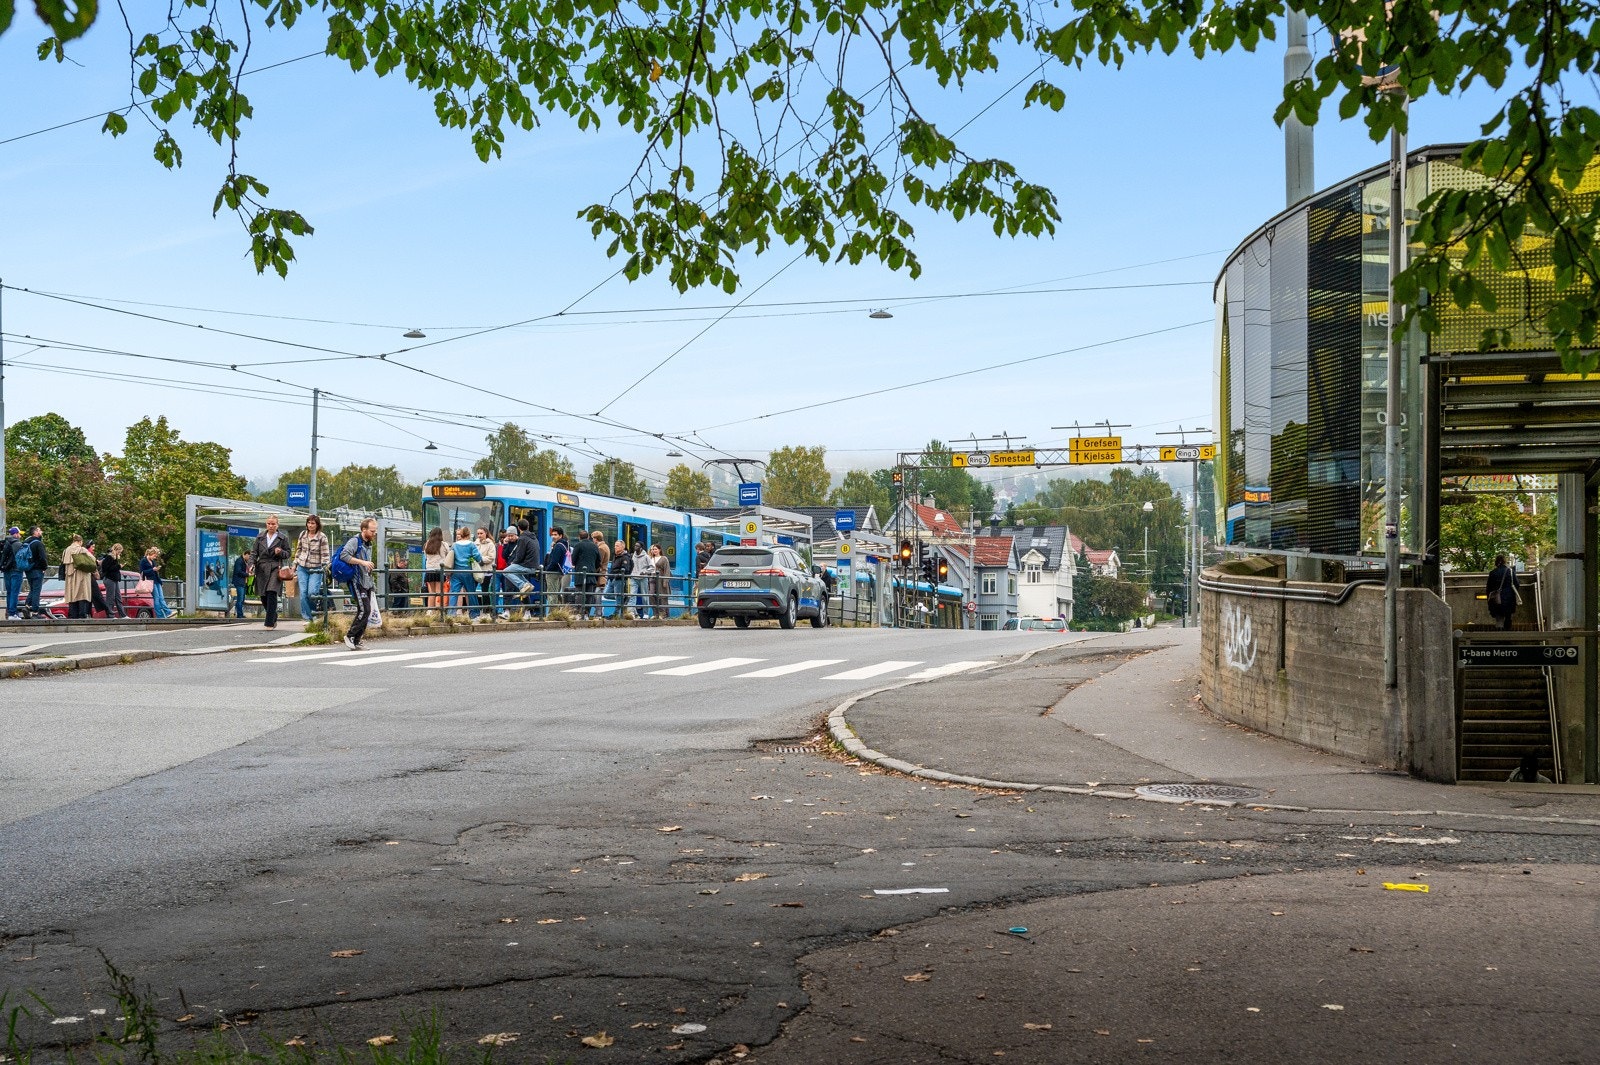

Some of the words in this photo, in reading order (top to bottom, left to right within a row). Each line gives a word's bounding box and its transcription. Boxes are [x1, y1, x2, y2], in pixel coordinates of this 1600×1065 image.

[1083, 439, 1118, 448] Grefsen
[993, 454, 1031, 463] Smestad
[1083, 451, 1116, 462] Kjelsås
[433, 487, 440, 496] 11
